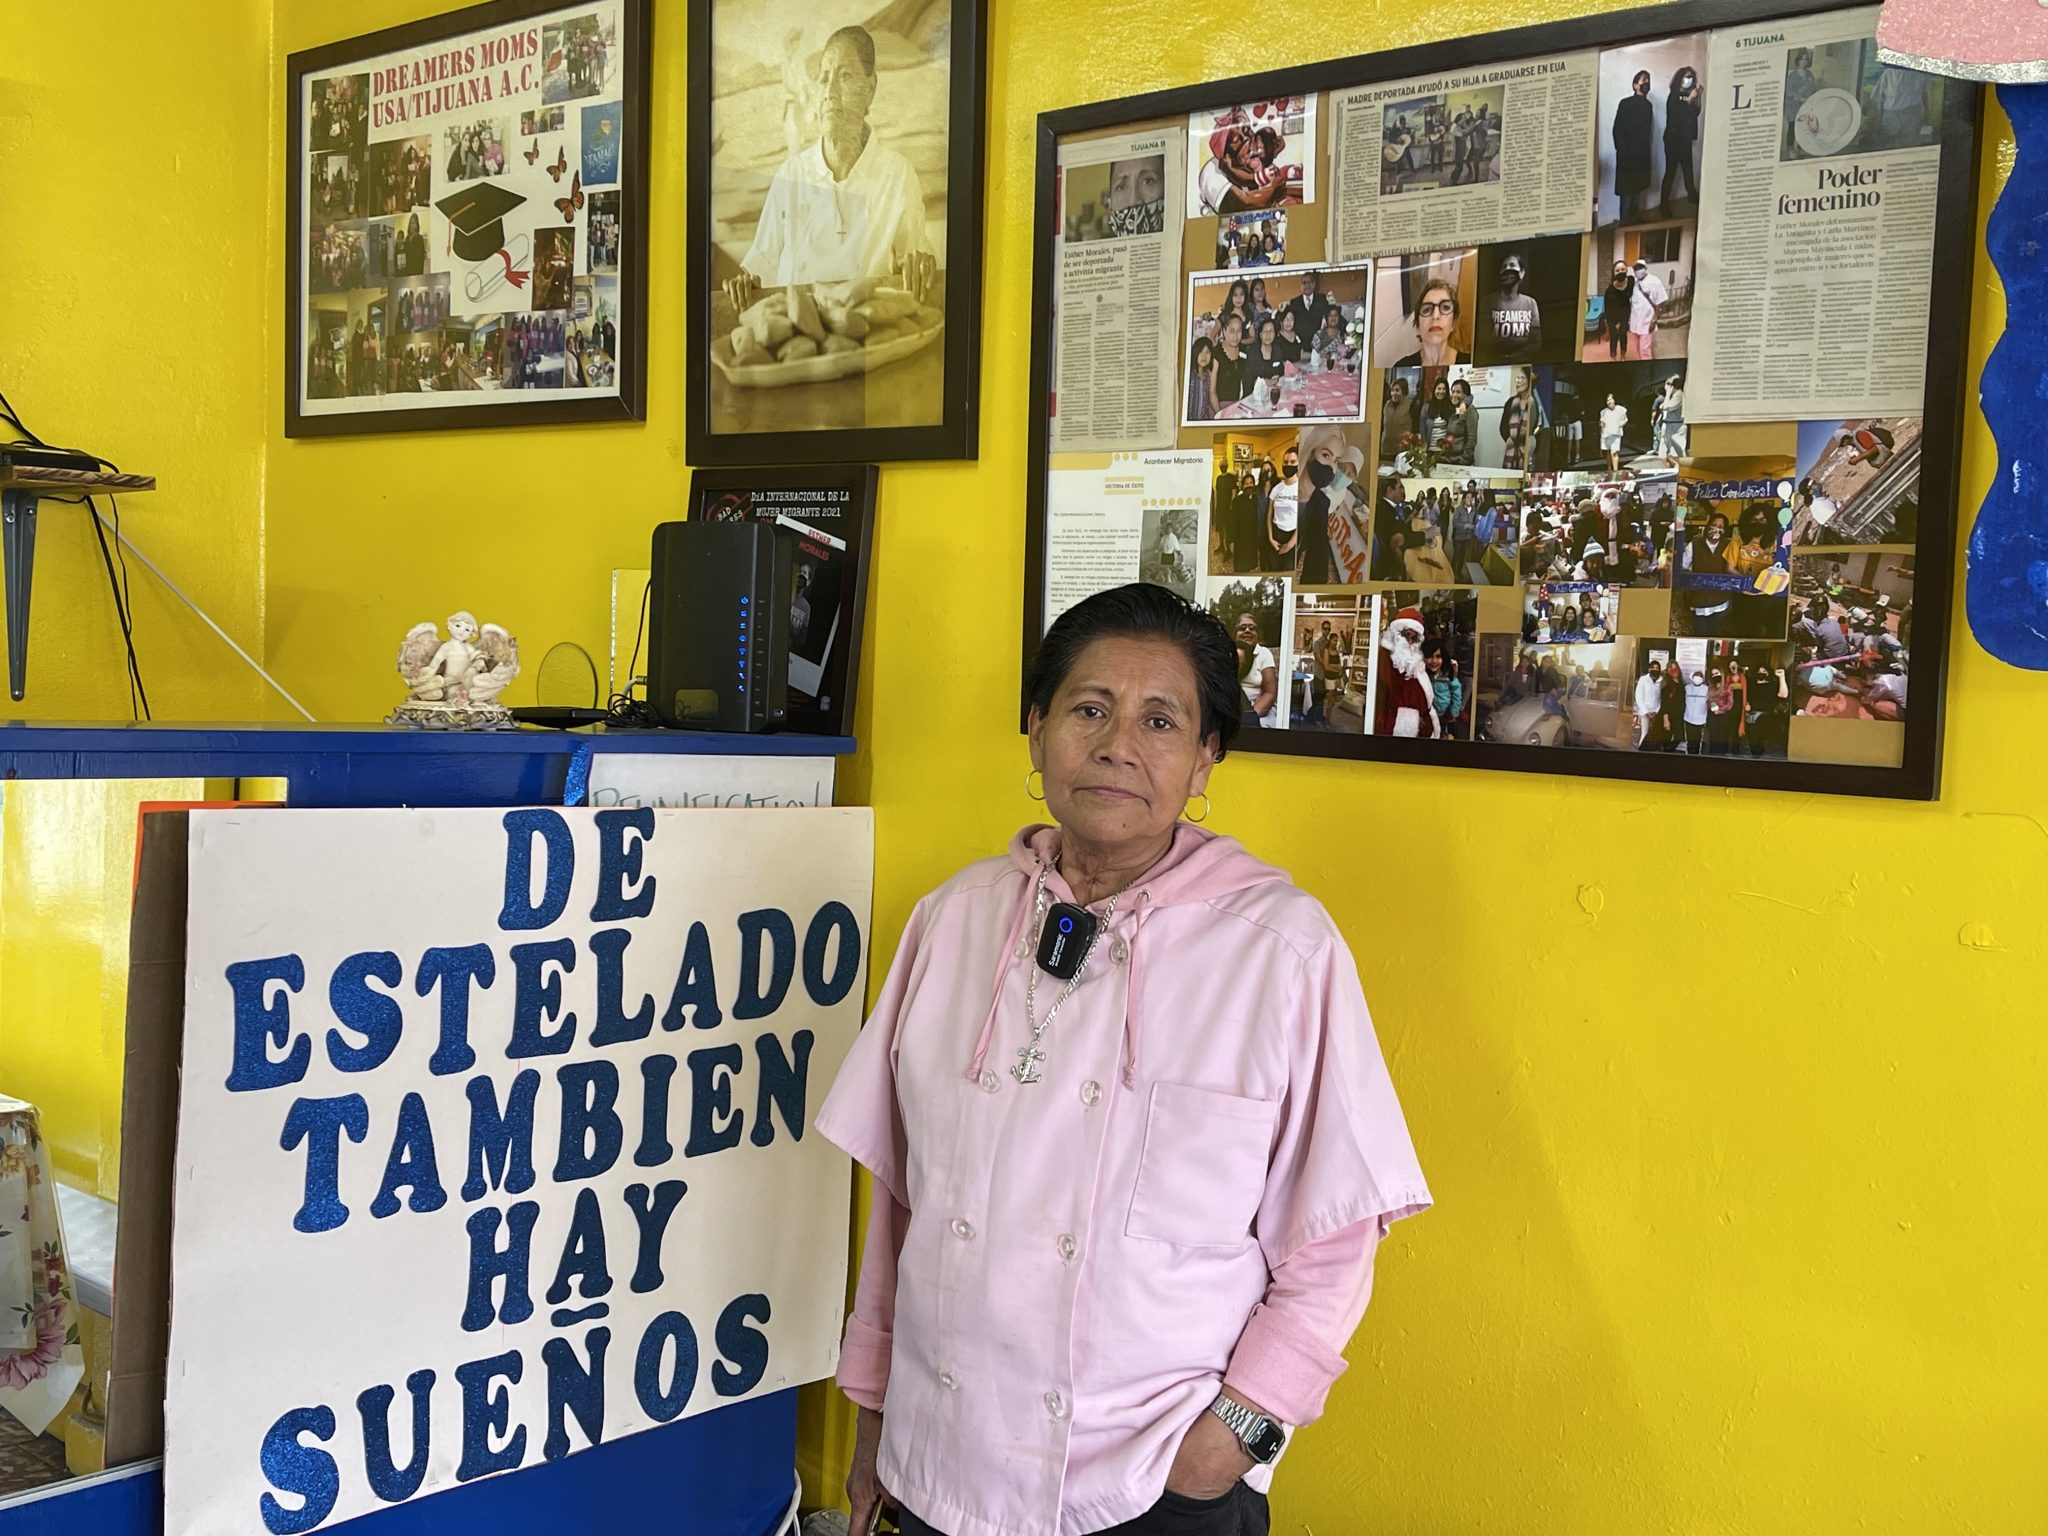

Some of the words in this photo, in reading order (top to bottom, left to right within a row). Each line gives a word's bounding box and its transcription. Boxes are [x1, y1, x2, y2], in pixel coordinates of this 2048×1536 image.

[1735, 39, 1742, 48] 6
[1743, 33, 1785, 47] TIJUANA
[373, 47, 475, 97] DREAMERS
[480, 28, 538, 69] MOMS
[1347, 93, 1372, 105] MADRE
[1374, 86, 1415, 100] DEPORTADA
[1417, 79, 1442, 94] AYUDÓ
[1443, 80, 1450, 90] A
[1451, 79, 1461, 89] SU
[1462, 76, 1480, 87] HIJA
[1481, 74, 1488, 84] A
[1488, 66, 1535, 82] GRADUARSE
[1537, 64, 1548, 75] EN
[1549, 61, 1566, 73] EUA
[372, 75, 493, 128] USA/TIJUANA
[499, 64, 539, 98] A.C.
[1131, 141, 1159, 151] TIJUANA
[1818, 165, 1883, 190] Poder
[1777, 189, 1881, 215] femenino
[1173, 457, 1204, 465] Migratorio
[766, 491, 826, 502] INTERNACIONAL
[828, 491, 839, 501] DE
[840, 491, 850, 501] LA
[756, 507, 780, 517] MUJER
[782, 507, 821, 517] MIGRANTE
[821, 507, 841, 517] 2021
[807, 529, 832, 545] ESTHER
[799, 541, 830, 561] MORALES
[499, 807, 656, 930] DE
[280, 1030, 815, 1233] TAMBIEN
[461, 1180, 687, 1331] HAY
[259, 1294, 771, 1536] SUEÑOS
